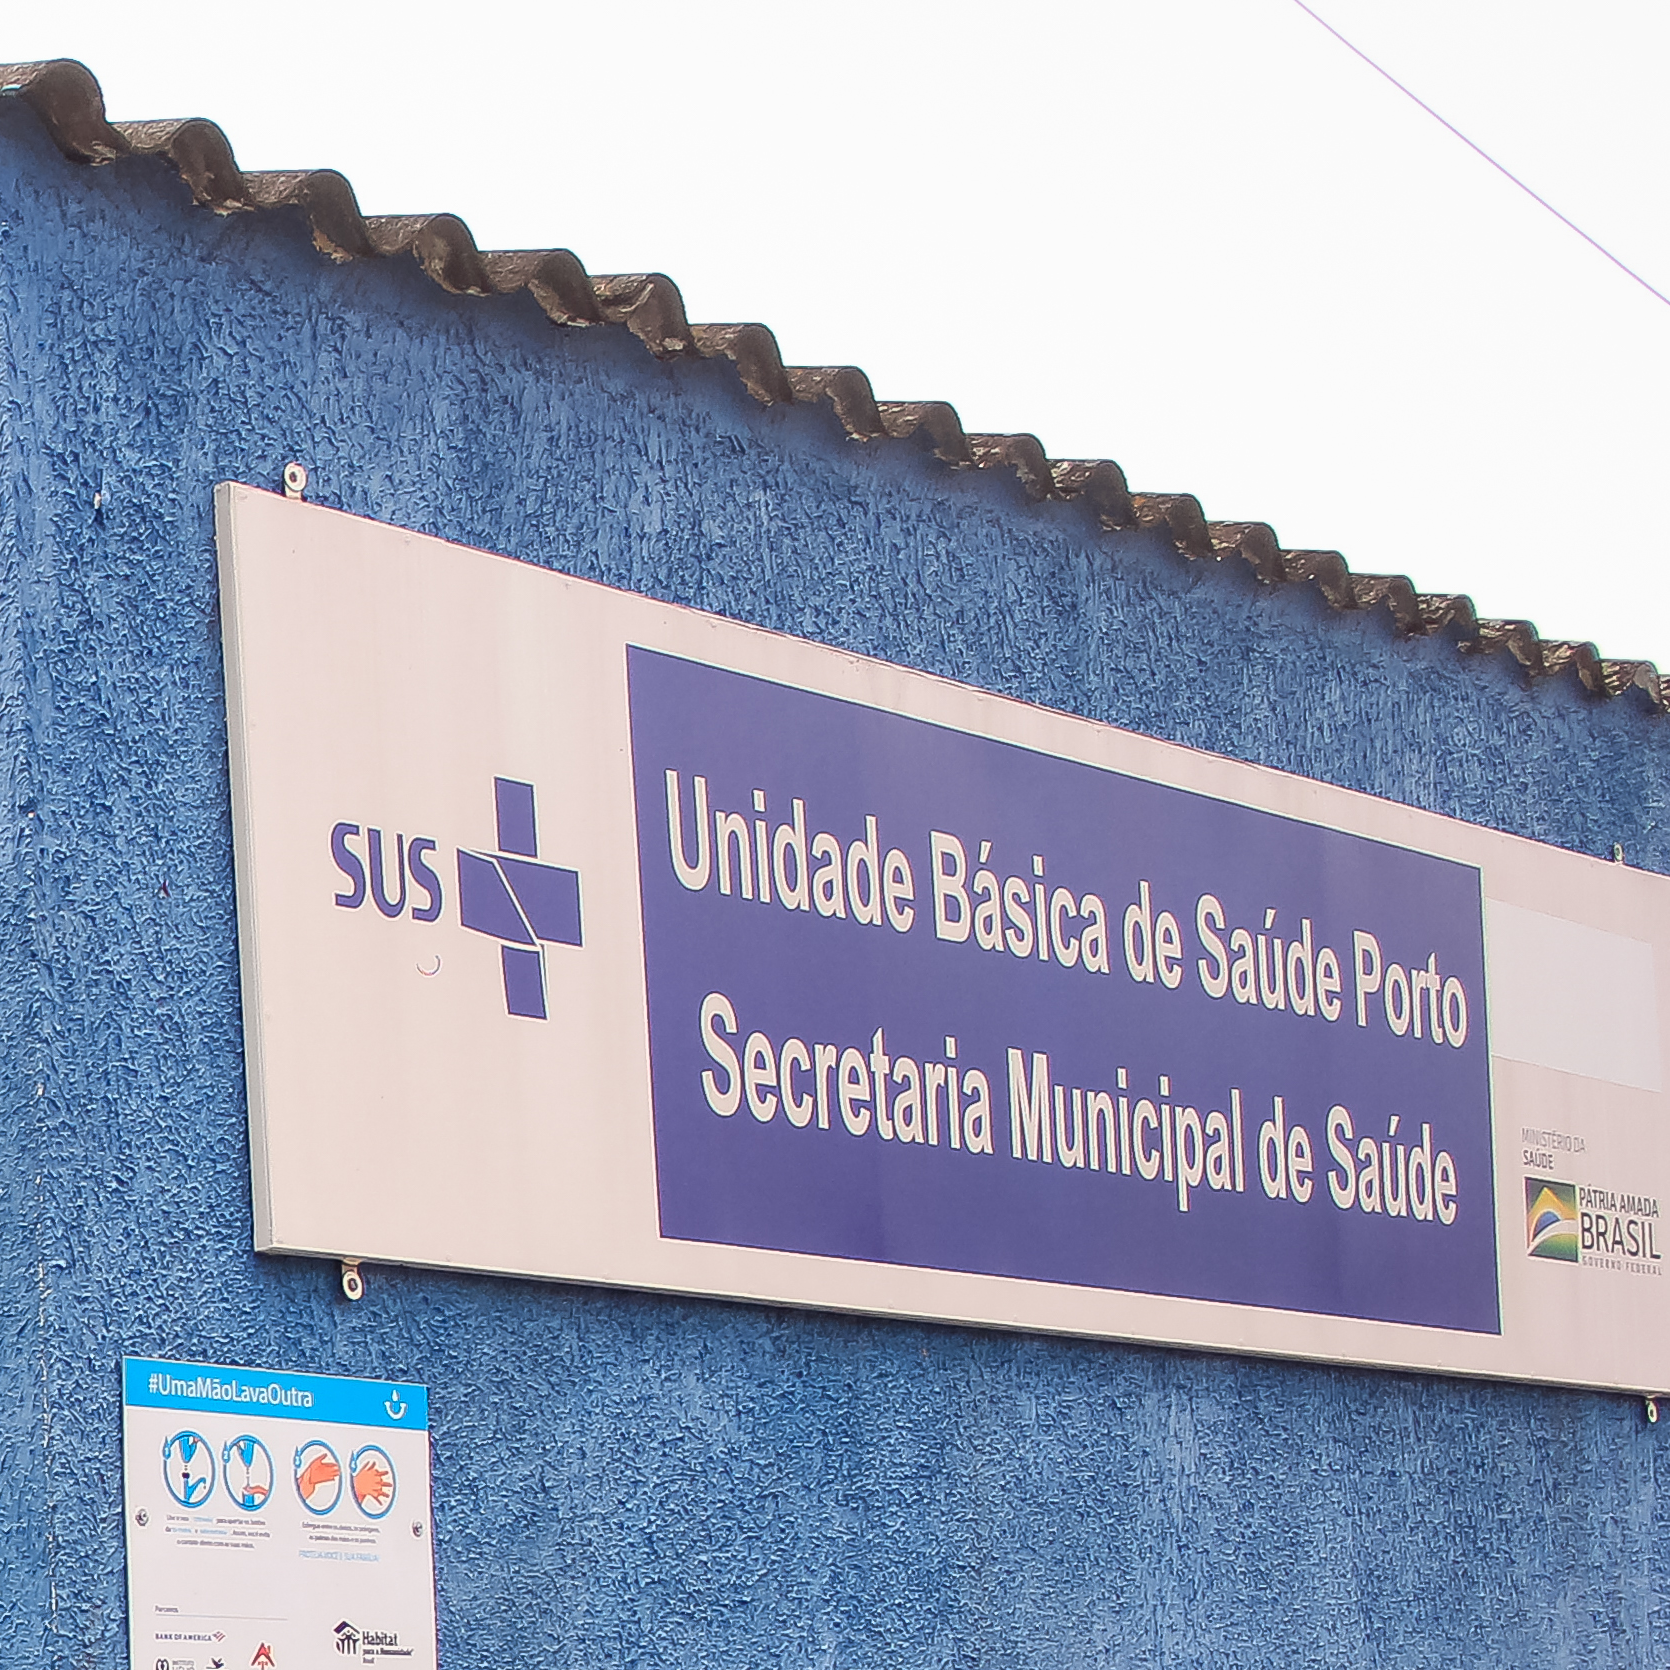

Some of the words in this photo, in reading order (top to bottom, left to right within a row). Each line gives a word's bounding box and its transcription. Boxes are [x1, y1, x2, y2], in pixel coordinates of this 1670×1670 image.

[331, 822, 443, 922] SUS
[664, 768, 915, 934] Unidade
[930, 829, 1110, 976] Básica
[1125, 900, 1184, 991] de
[1195, 893, 1342, 1022] Saúde
[1356, 928, 1469, 1050] Porto
[700, 991, 994, 1155] Secretaria
[1009, 1046, 1245, 1212] Municipal
[1258, 1093, 1314, 1204] de
[1326, 1104, 1459, 1227] Saúde
[1522, 1127, 1572, 1151] MINISTÉRIO
[1574, 1136, 1586, 1153] DA
[1523, 1147, 1554, 1170] SAÚDE
[1579, 1183, 1617, 1211] PÁTRIA
[1619, 1193, 1660, 1218] AMADA
[1581, 1211, 1662, 1260] BRASIL
[1582, 1256, 1622, 1271] GOVERNO
[1625, 1263, 1663, 1276] FEDERAL
[147, 1373, 314, 1408] #UmaMãoLavaOutra
[183, 1634, 212, 1642] AMERICA
[362, 1630, 398, 1646] Habitat
